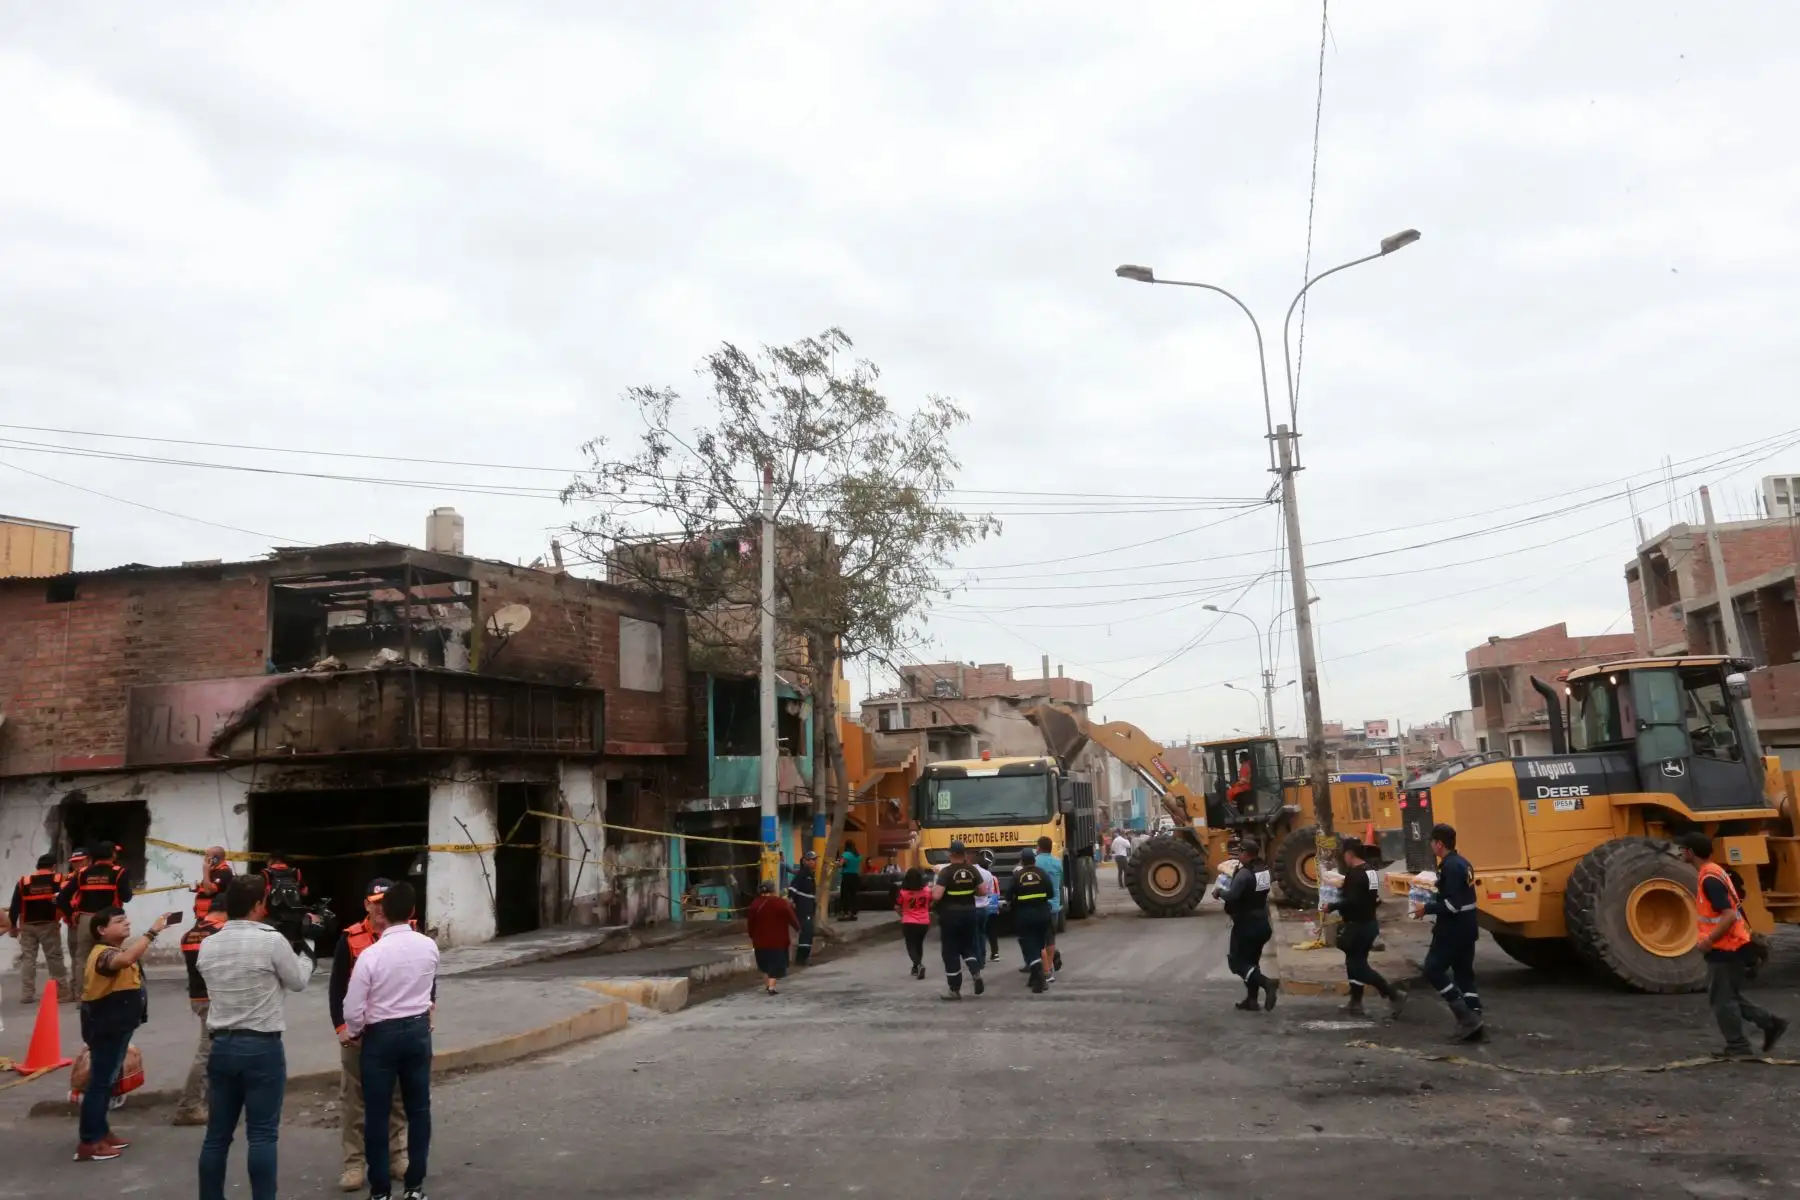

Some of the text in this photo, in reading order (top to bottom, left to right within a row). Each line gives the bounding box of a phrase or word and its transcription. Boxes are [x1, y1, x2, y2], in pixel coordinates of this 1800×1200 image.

[1536, 785, 1590, 798] DEERE
[985, 832, 998, 842] DEL
[1000, 831, 1019, 841] PERU
